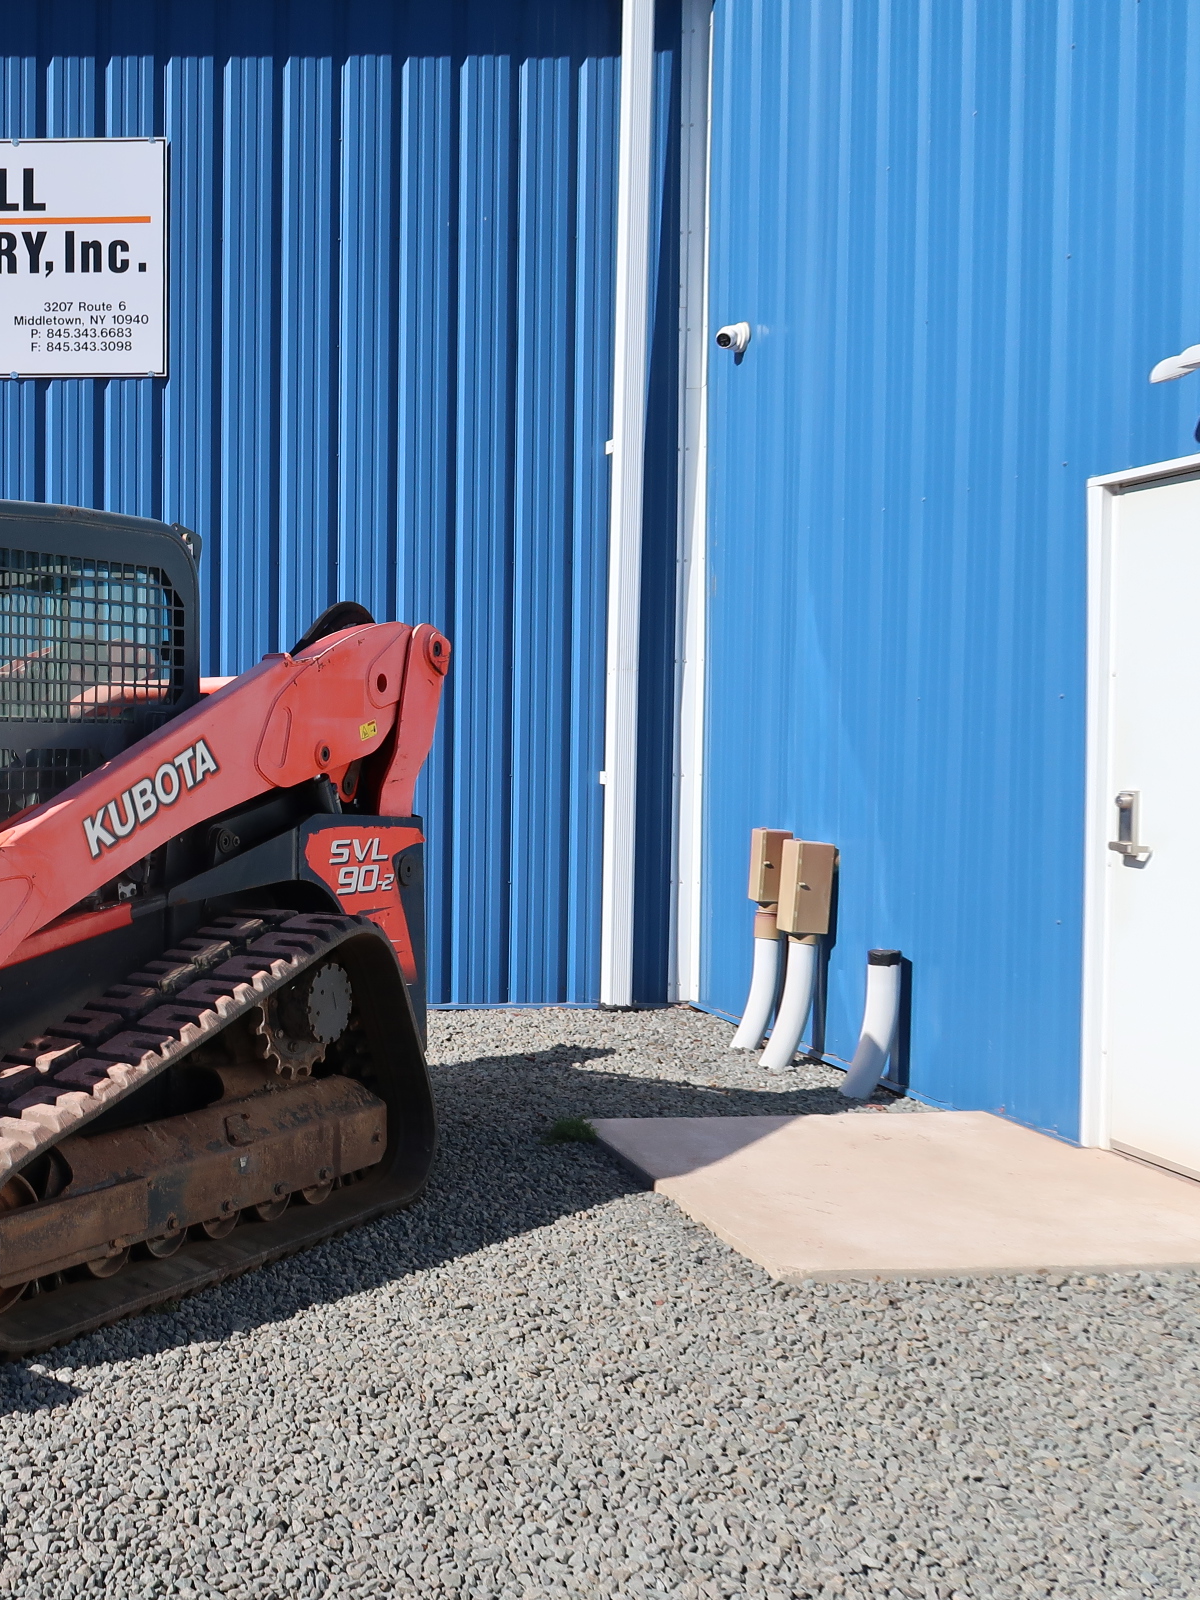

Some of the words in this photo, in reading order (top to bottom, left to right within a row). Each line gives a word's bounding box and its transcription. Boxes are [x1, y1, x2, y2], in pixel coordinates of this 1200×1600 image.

[65, 231, 147, 273] Inc.
[43, 301, 74, 313] 3207
[78, 301, 113, 312] Route
[118, 300, 127, 312] 6
[13, 315, 85, 327] Middletown,
[89, 314, 107, 325] NY
[111, 314, 149, 325] 10940
[30, 328, 41, 339] P:
[46, 327, 133, 339] 845.343.6683
[30, 341, 41, 353] F:
[46, 340, 133, 353] 845.343.3098
[82, 738, 218, 858] KUBOTA
[329, 837, 388, 865] SVL
[336, 864, 394, 895] 90-2
